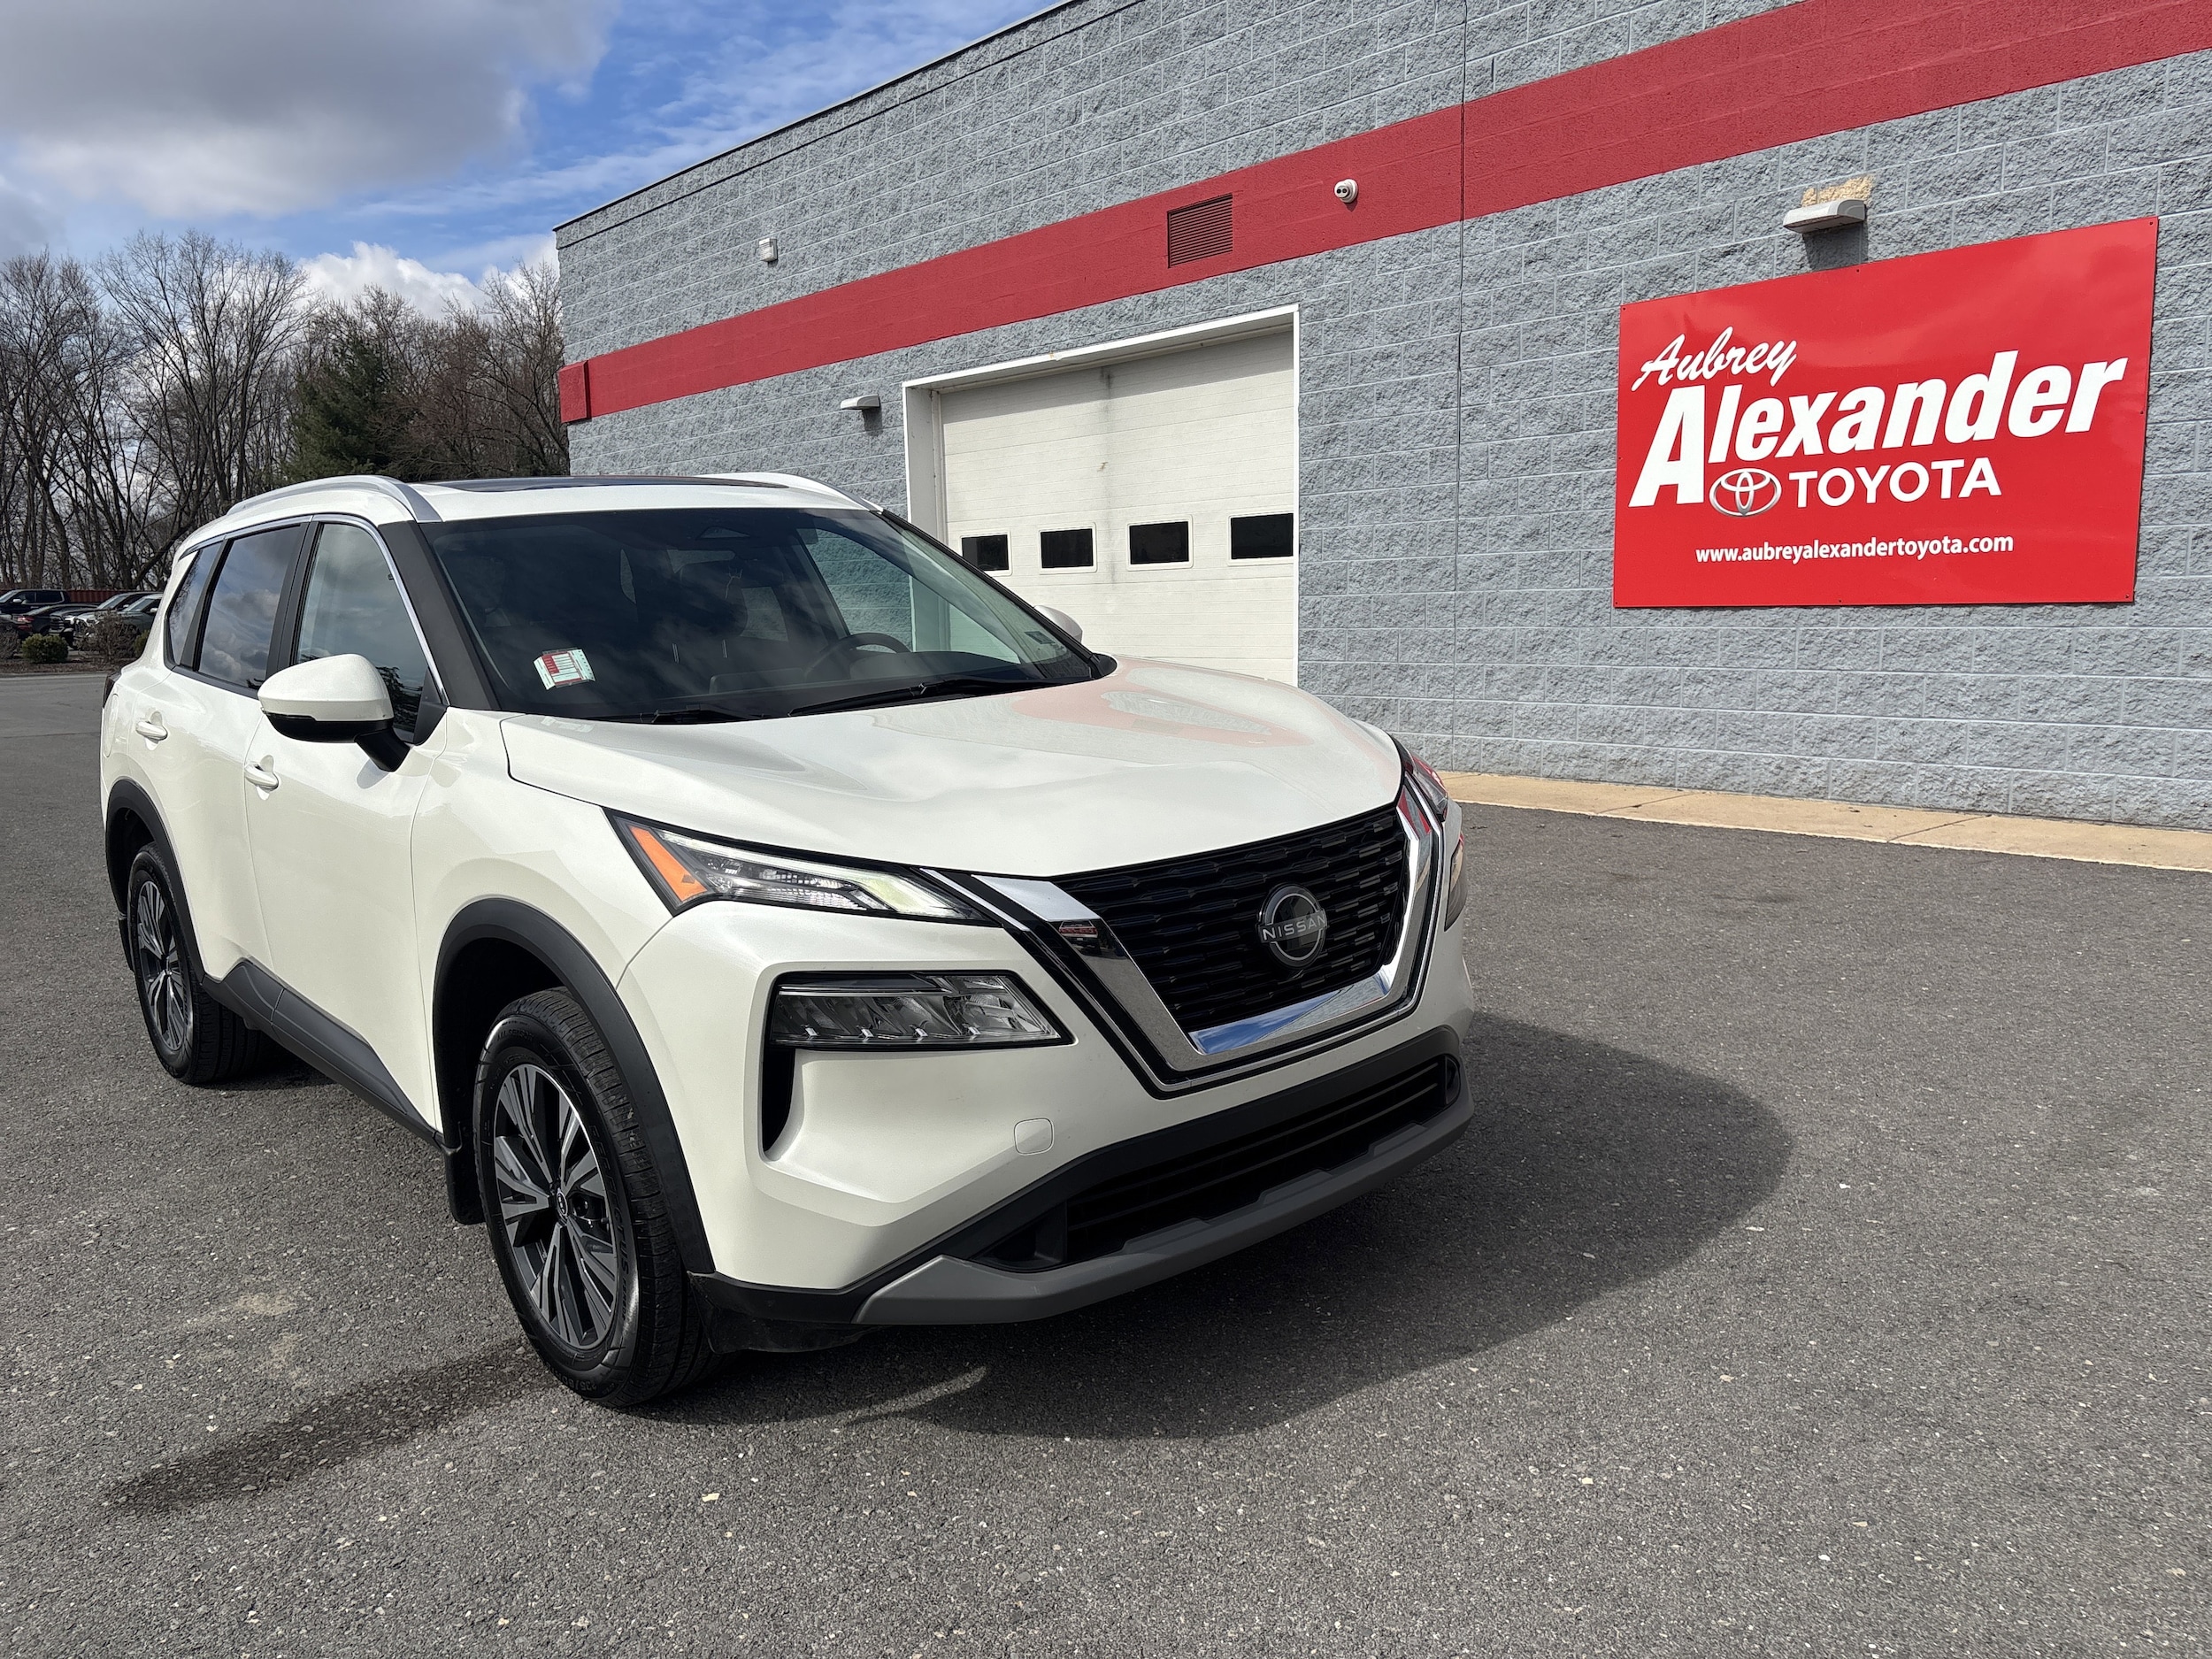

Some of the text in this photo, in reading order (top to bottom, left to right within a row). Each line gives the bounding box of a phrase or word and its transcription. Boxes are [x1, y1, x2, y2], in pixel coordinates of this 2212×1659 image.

[1631, 326, 1798, 392] Aubrey
[1628, 349, 2129, 509] Alexander
[1788, 457, 2002, 509] TOYOTA
[1695, 534, 2015, 565] www.aubreyalexandertoyota.com
[1262, 913, 1325, 941] NISSAN
